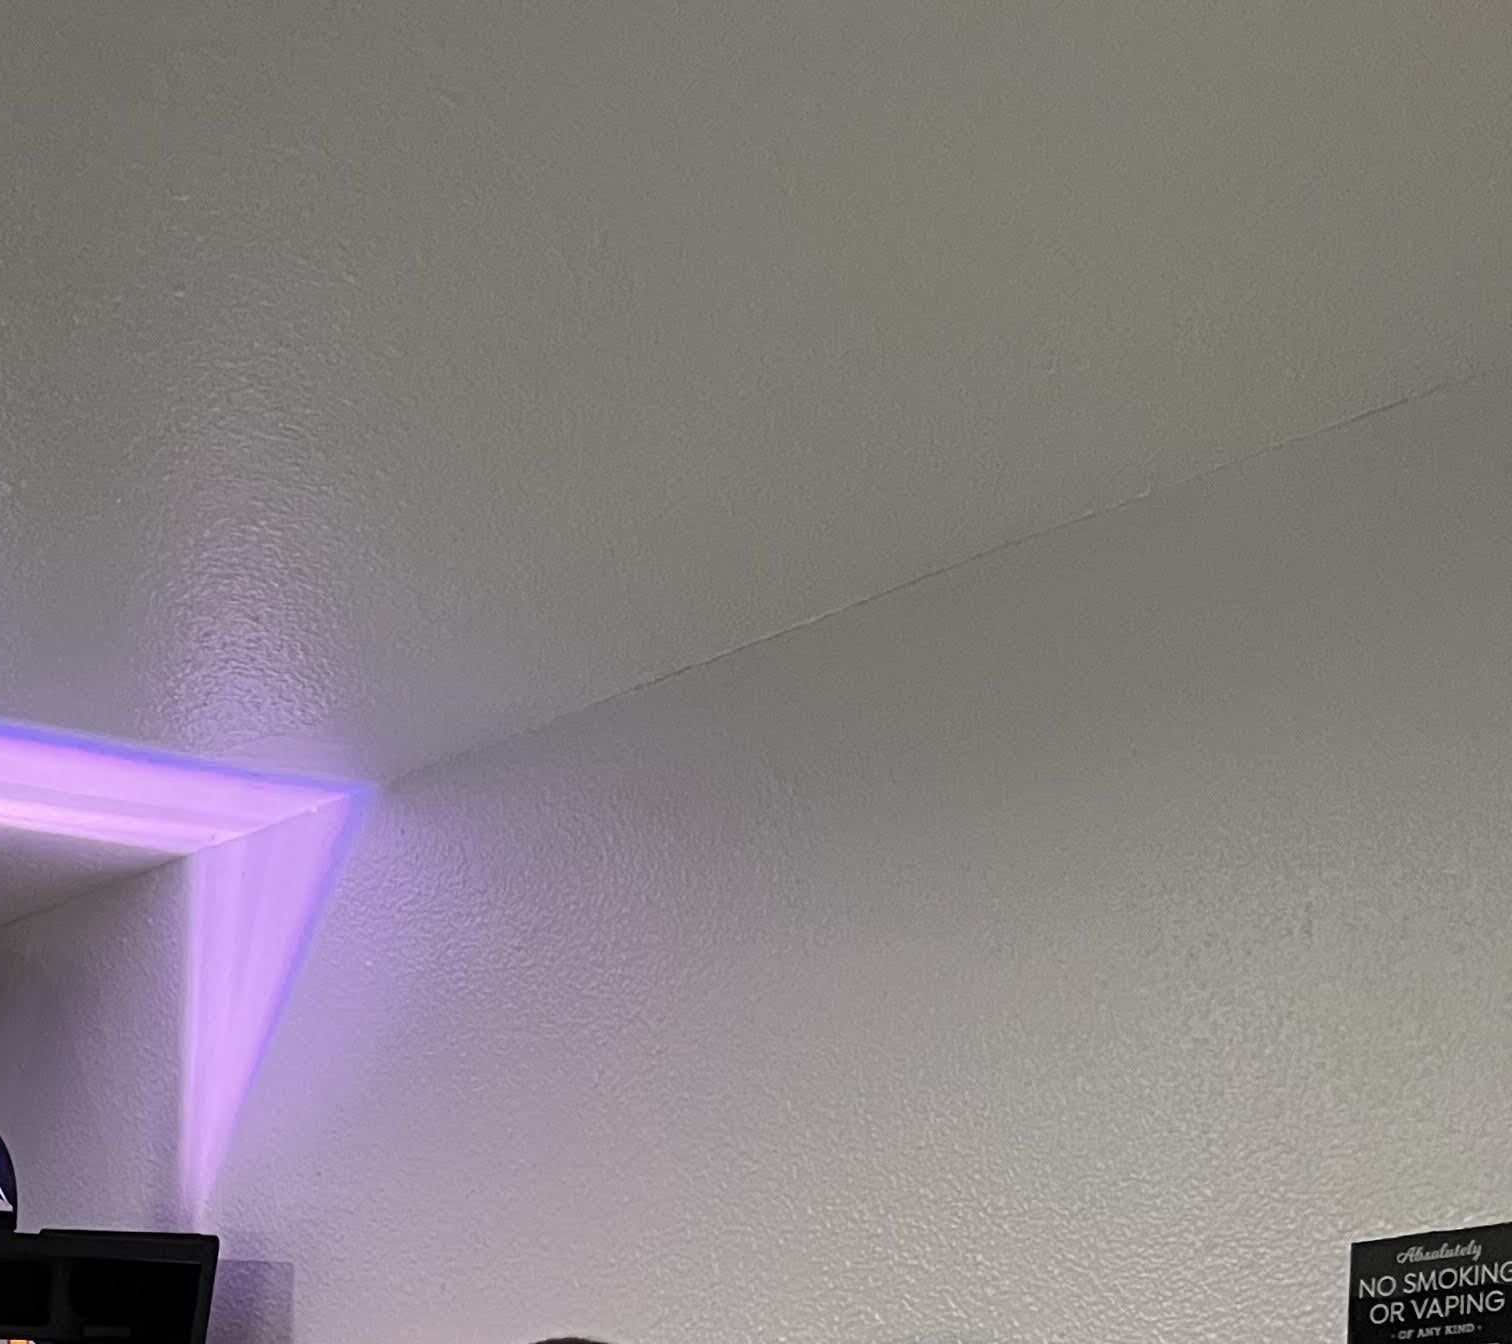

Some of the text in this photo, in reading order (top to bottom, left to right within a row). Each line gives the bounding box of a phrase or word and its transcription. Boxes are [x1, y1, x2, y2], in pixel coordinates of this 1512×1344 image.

[1396, 1240, 1482, 1264] Absolutely
[1359, 1261, 1512, 1299] NO SMOKING
[1369, 1290, 1505, 1324] OR VAPING
[1416, 1327, 1442, 1338] ANY
[1445, 1323, 1475, 1335] KIND
